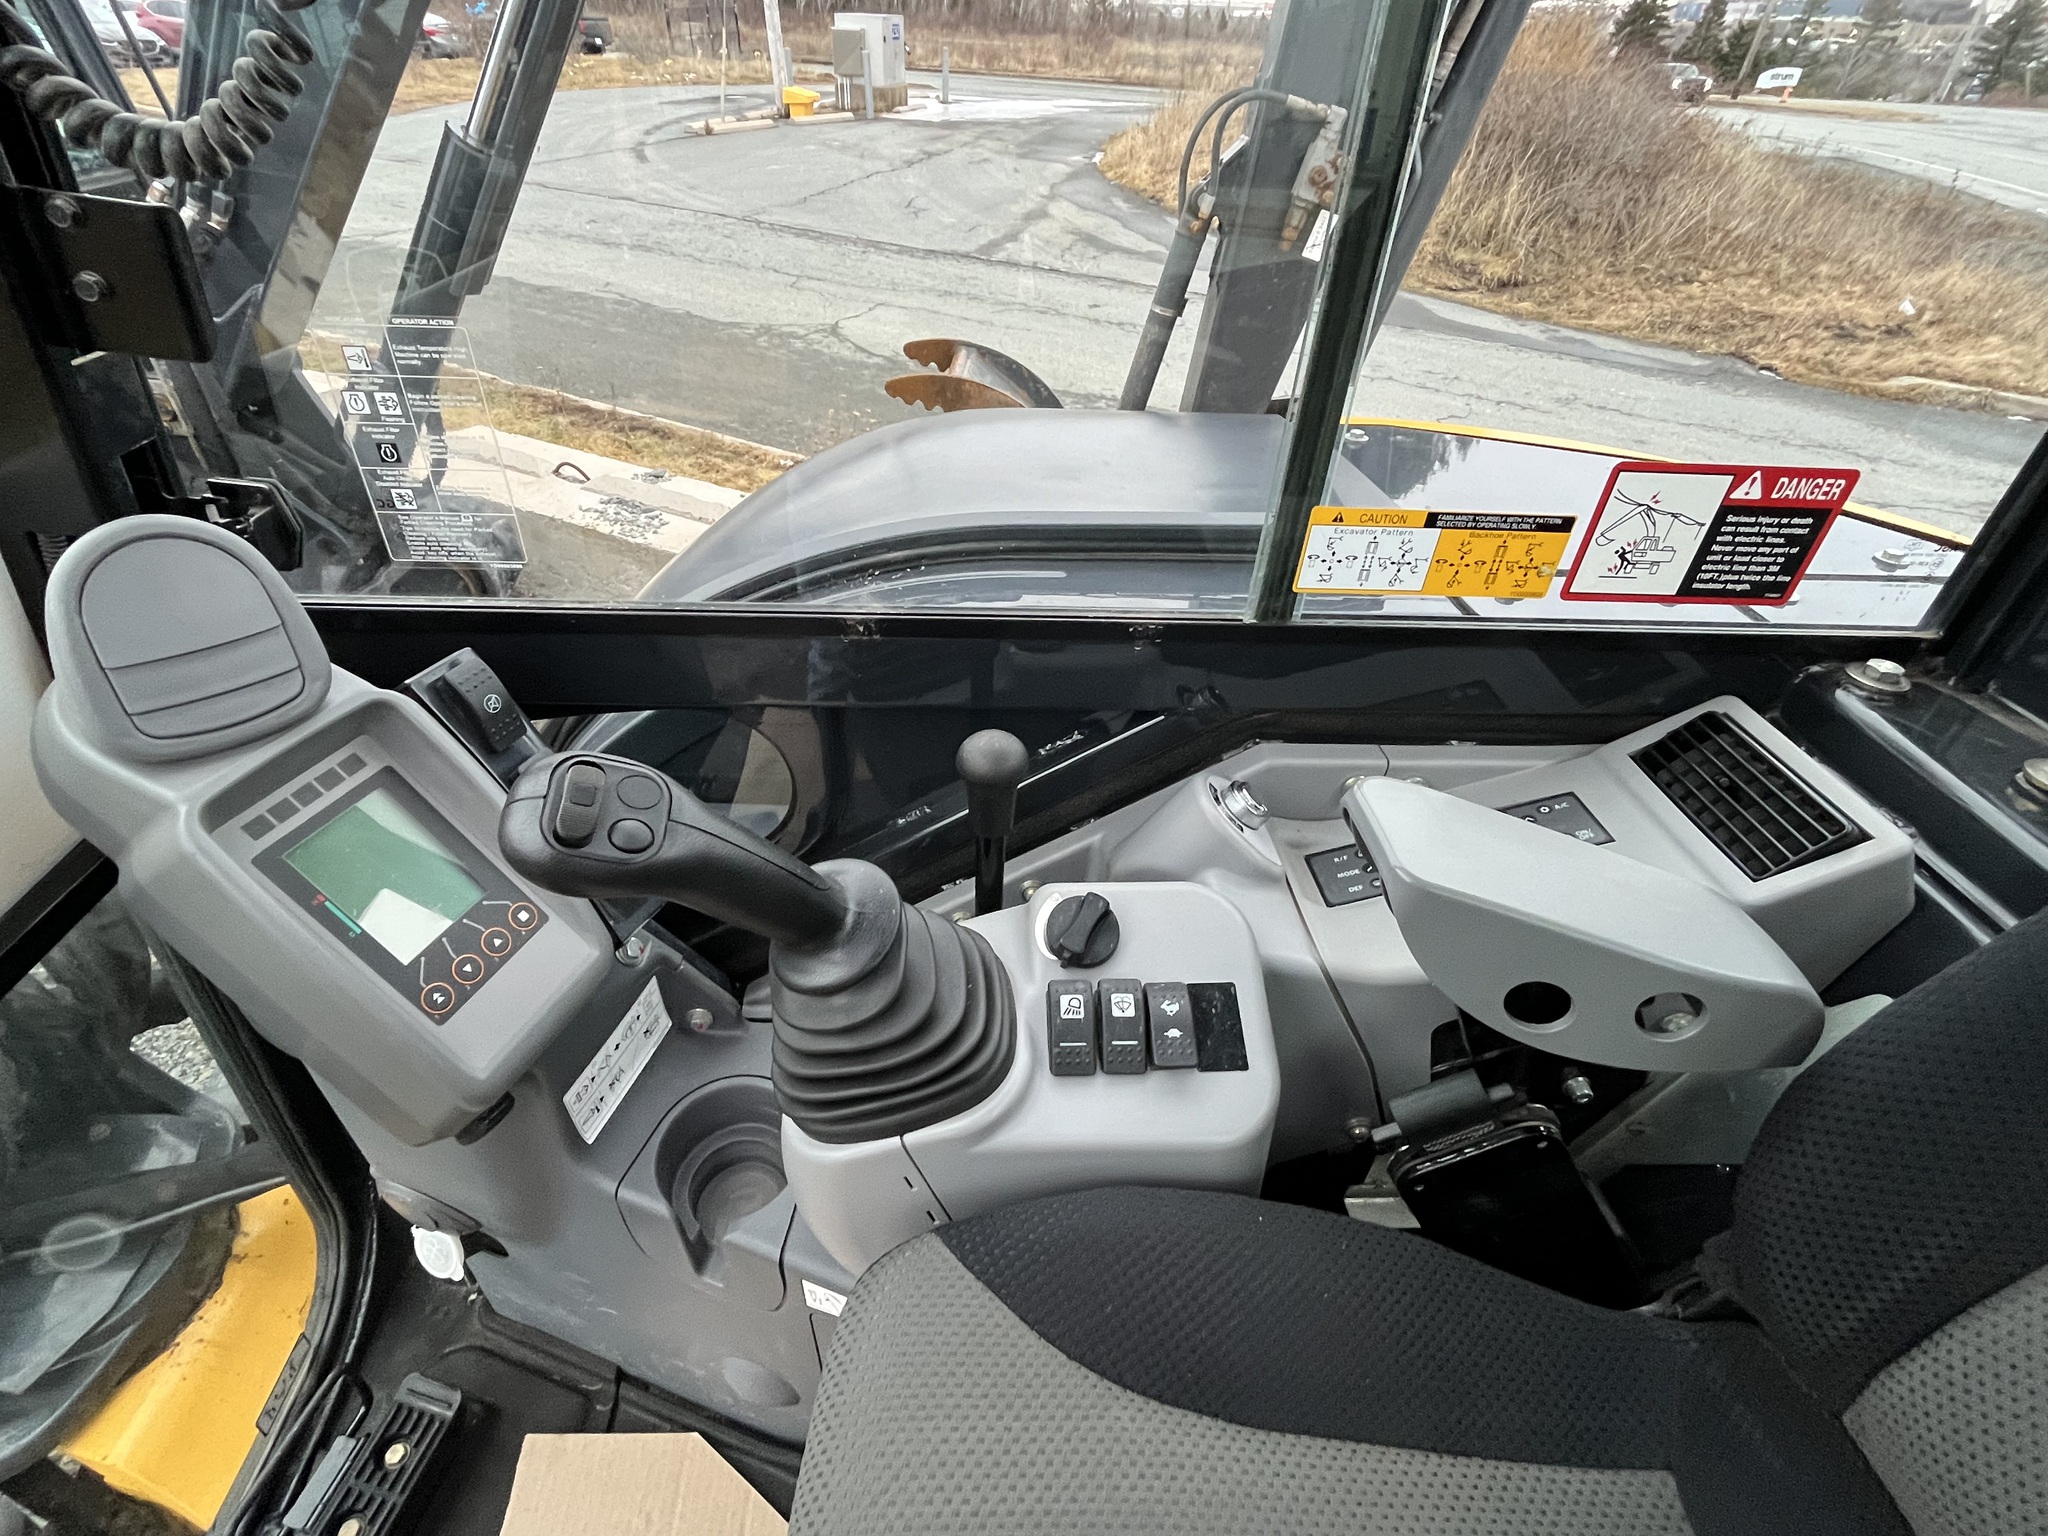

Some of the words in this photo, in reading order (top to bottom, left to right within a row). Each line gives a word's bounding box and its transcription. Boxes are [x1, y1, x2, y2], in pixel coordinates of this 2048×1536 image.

[1770, 72, 1794, 80] strum
[1770, 476, 1847, 501] DANGER
[1359, 513, 1409, 524] CAUTION
[1725, 514, 1757, 523] Serious
[1757, 515, 1780, 525] injury
[1790, 516, 1814, 525] death
[1333, 527, 1378, 536] Excavator
[1380, 528, 1414, 536] Pattern
[1736, 525, 1760, 533] result
[1468, 531, 1504, 539] Backhoe
[1506, 532, 1537, 540] Pattern
[1734, 535, 1765, 543] electric
[1765, 536, 1786, 544] lines.
[1711, 544, 1735, 552] Never
[1757, 546, 1773, 555] any
[1771, 546, 1789, 554] part
[1789, 546, 1800, 554] of
[1751, 555, 1776, 563] closer
[1701, 563, 1731, 571] electric
[1748, 564, 1767, 572] than
[1761, 574, 1776, 582] the
[1725, 582, 1751, 592] length.
[1554, 802, 1570, 810] A/C
[1579, 831, 1595, 840] OFF
[1337, 868, 1361, 878] MODE
[1348, 884, 1364, 893] DEF
